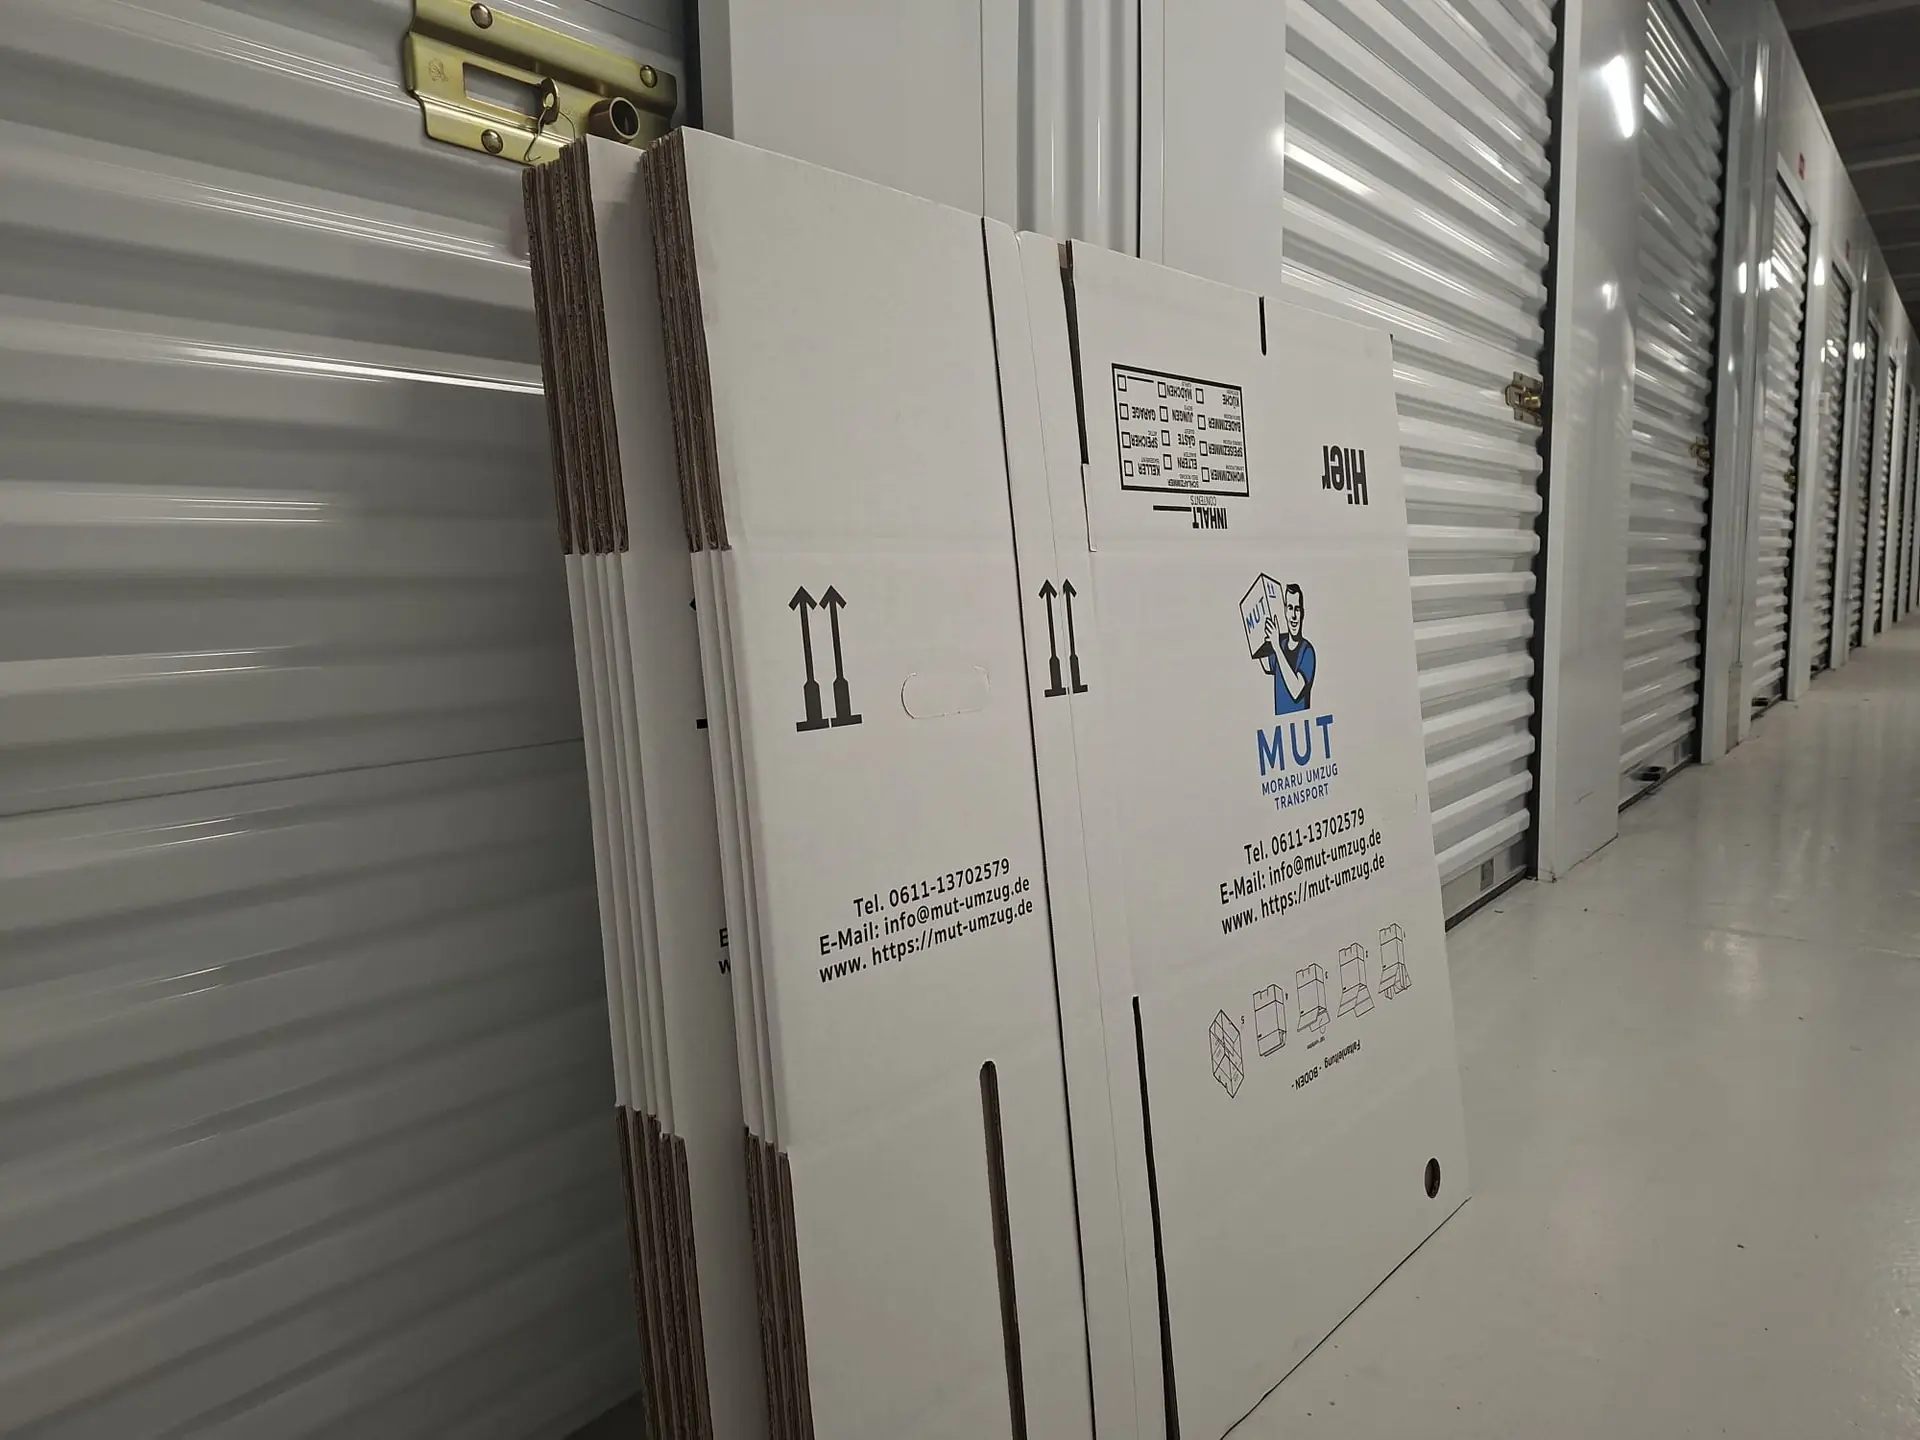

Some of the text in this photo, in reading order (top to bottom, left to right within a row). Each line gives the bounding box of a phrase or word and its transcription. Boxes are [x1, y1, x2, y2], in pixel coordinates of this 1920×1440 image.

[1167, 385, 1193, 402] MÄDCHEN
[1222, 394, 1240, 409] KÜCHE
[1131, 406, 1156, 421] GARAGE
[1171, 409, 1194, 423] JUNGEN
[1208, 418, 1241, 432] BADEZIMMER
[1131, 435, 1159, 449] SPEICHER
[1177, 433, 1196, 448] GÄSTE
[1208, 443, 1243, 457] SPEISEZIMMER
[1138, 463, 1161, 476] KELLER
[1177, 457, 1198, 470] ELTERN
[1210, 469, 1245, 482] WOHNZIMMER
[1322, 445, 1368, 505] Hier
[1190, 496, 1217, 506] CONTENTS
[1192, 507, 1228, 529] INHALT
[1246, 596, 1265, 634] MUT
[1257, 714, 1334, 776] MUT
[1261, 763, 1338, 796] MORARU UMZUG
[1274, 783, 1329, 810] TRANSPORT
[1243, 807, 1365, 865] Tel. 0611-13702579
[1219, 828, 1382, 905] E-Mail: info@mut-umzug.de
[853, 857, 1010, 918] Tel. 0611-13702579
[1221, 852, 1385, 934] www. https://mut-umzug.de
[819, 876, 1030, 956] E-Mail: info@mut-umzug.de
[819, 898, 1033, 983] www. https://mut-umzug.de
[1324, 1039, 1362, 1069] Faltanleitung
